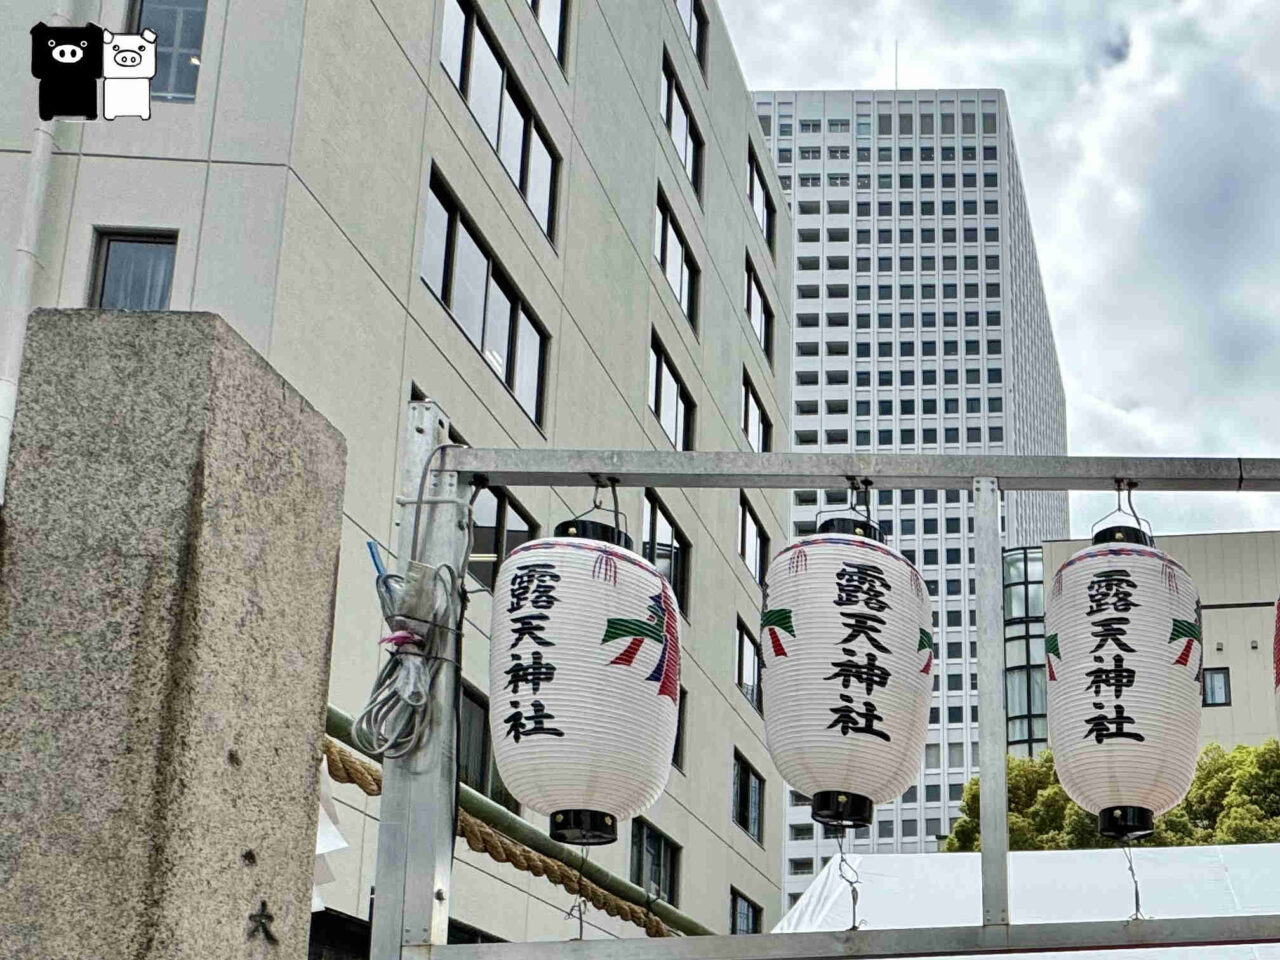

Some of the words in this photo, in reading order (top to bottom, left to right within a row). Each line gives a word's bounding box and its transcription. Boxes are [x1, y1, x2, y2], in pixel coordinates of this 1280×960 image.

[503, 563, 565, 743] 露天神社
[823, 562, 892, 742] 露天神社
[1083, 569, 1145, 744] 露天神社
